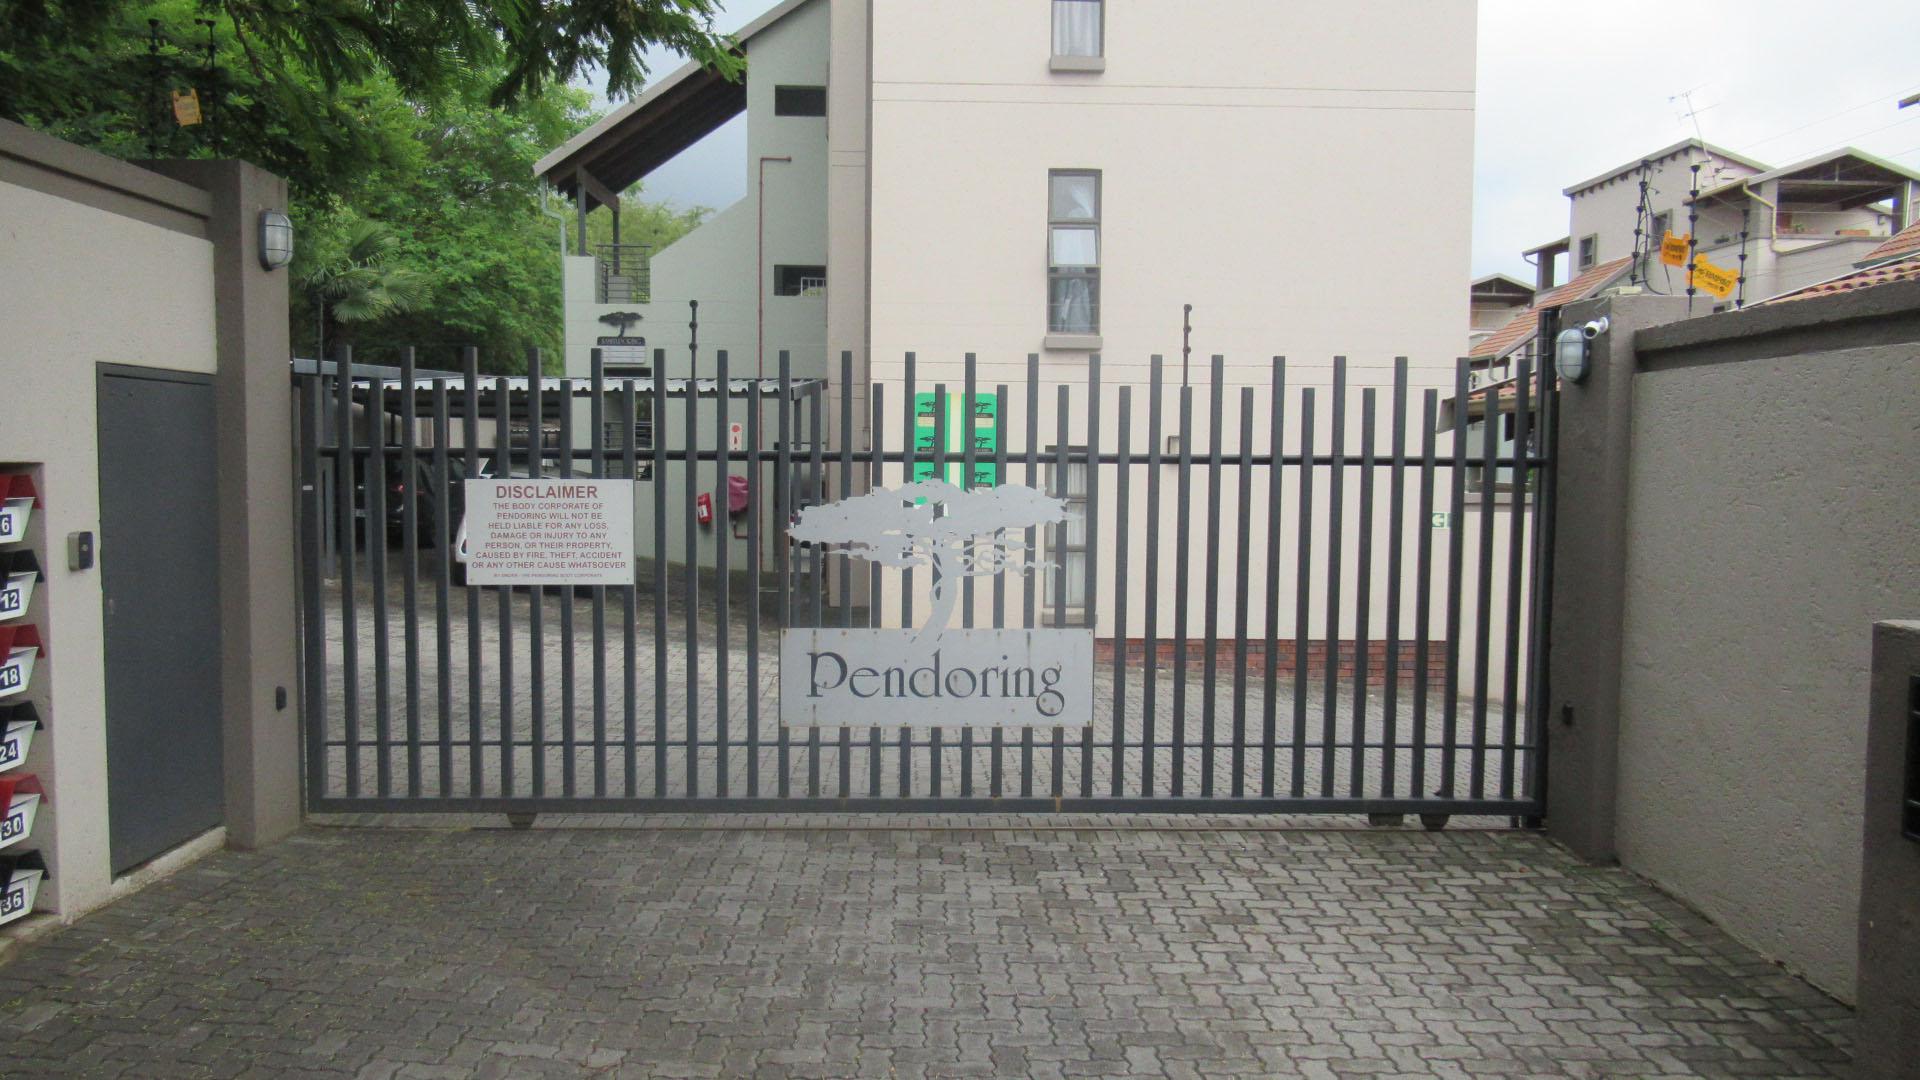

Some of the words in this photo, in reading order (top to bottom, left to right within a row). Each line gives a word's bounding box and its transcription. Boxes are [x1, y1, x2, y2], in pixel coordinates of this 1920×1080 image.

[496, 485, 598, 499] DISCLAIMER
[493, 502, 509, 510] THE
[512, 502, 535, 510] BODY
[538, 502, 590, 510] CORPORATE
[592, 502, 604, 510] OF
[497, 512, 547, 520] PENDORING
[549, 512, 569, 520] WILL
[571, 512, 588, 520] NOT
[591, 512, 602, 520] BE
[1, 517, 10, 533] 6
[488, 522, 511, 530] HELD
[513, 522, 542, 530] LIABLE
[545, 522, 563, 530] FOR
[565, 522, 582, 530] ANY
[524, 541, 537, 549] OR
[540, 541, 564, 549] THEIR
[475, 551, 511, 559] CAUSED
[513, 551, 524, 559] BY
[580, 551, 622, 559] ACCIDENT
[471, 561, 485, 569] OR
[486, 561, 504, 569] ANY
[505, 561, 535, 569] OTHER
[537, 561, 566, 569] CAUSE
[568, 561, 626, 569] WHATSOEVER
[0, 592, 18, 609] 12
[0, 667, 18, 685] 18
[806, 649, 1065, 717] Pendoring
[0, 742, 16, 760] 24
[3, 816, 21, 837] 30
[2, 892, 22, 912] 36
